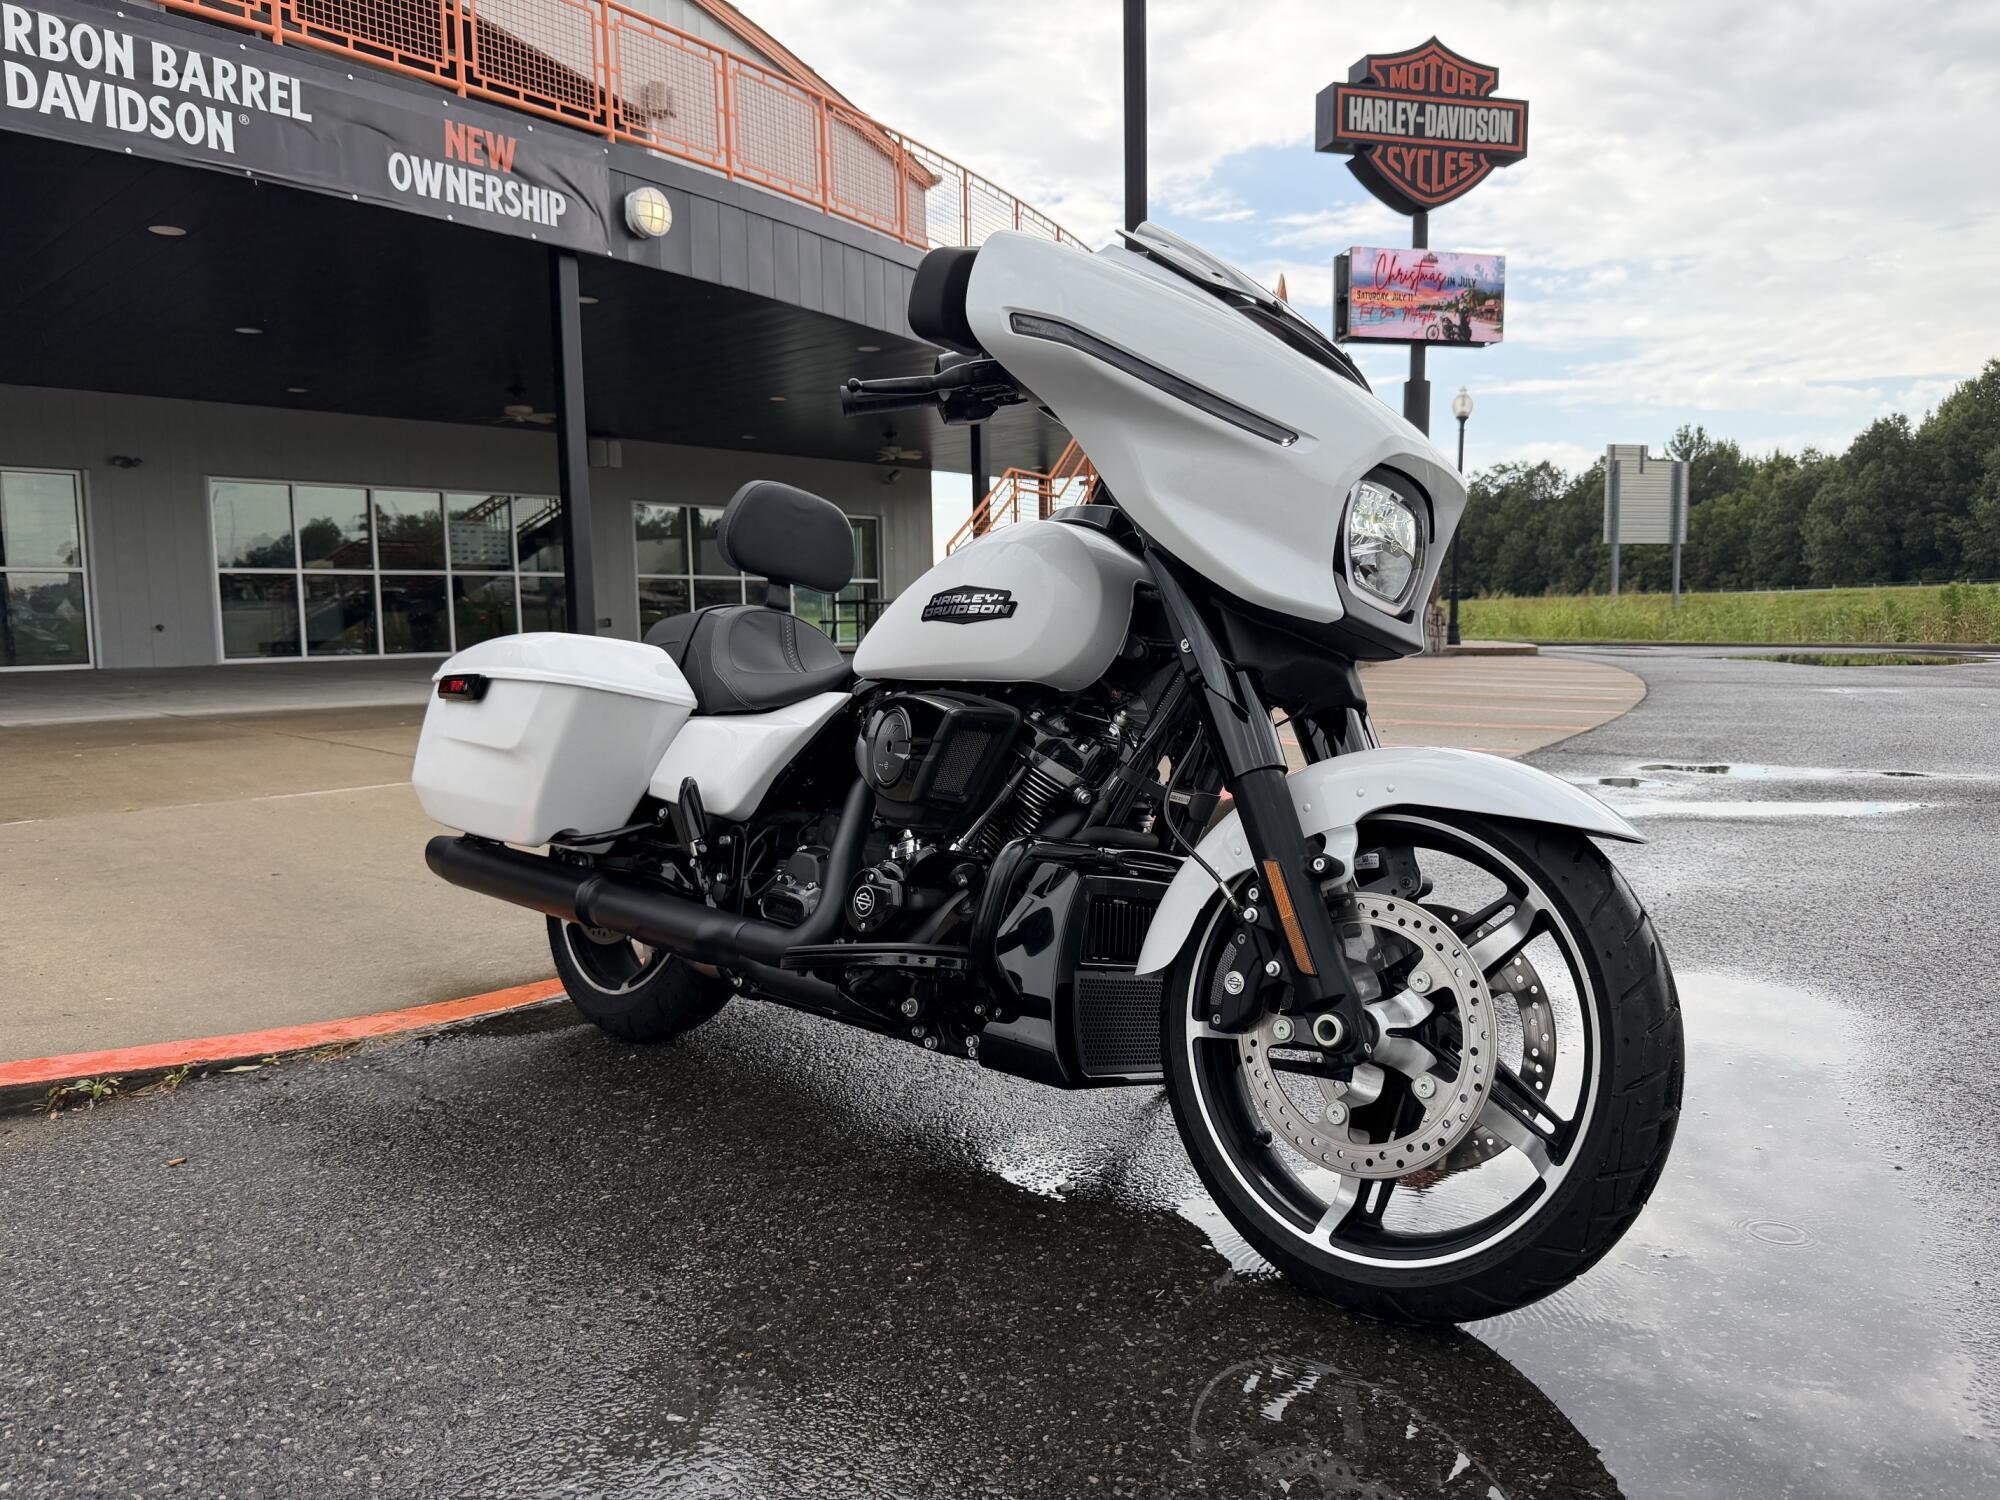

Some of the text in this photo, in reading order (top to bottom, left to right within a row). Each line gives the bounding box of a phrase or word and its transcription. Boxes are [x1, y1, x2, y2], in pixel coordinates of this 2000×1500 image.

[2, 2, 312, 123] RBON BARREL
[1389, 55, 1478, 96] MOTOR
[1348, 96, 1513, 144] HARLEY-DAVIDSON
[445, 119, 517, 174] NEW
[388, 152, 566, 227] OWNERSHIP
[1387, 146, 1475, 193] CYCLES
[1375, 252, 1446, 295] Christmas
[1447, 276, 1456, 287] IN
[1457, 276, 1477, 288] JULY
[1391, 292, 1406, 302] JULY
[924, 604, 1010, 617] DAVIDSON
[931, 593, 1005, 606] HARLEY-
